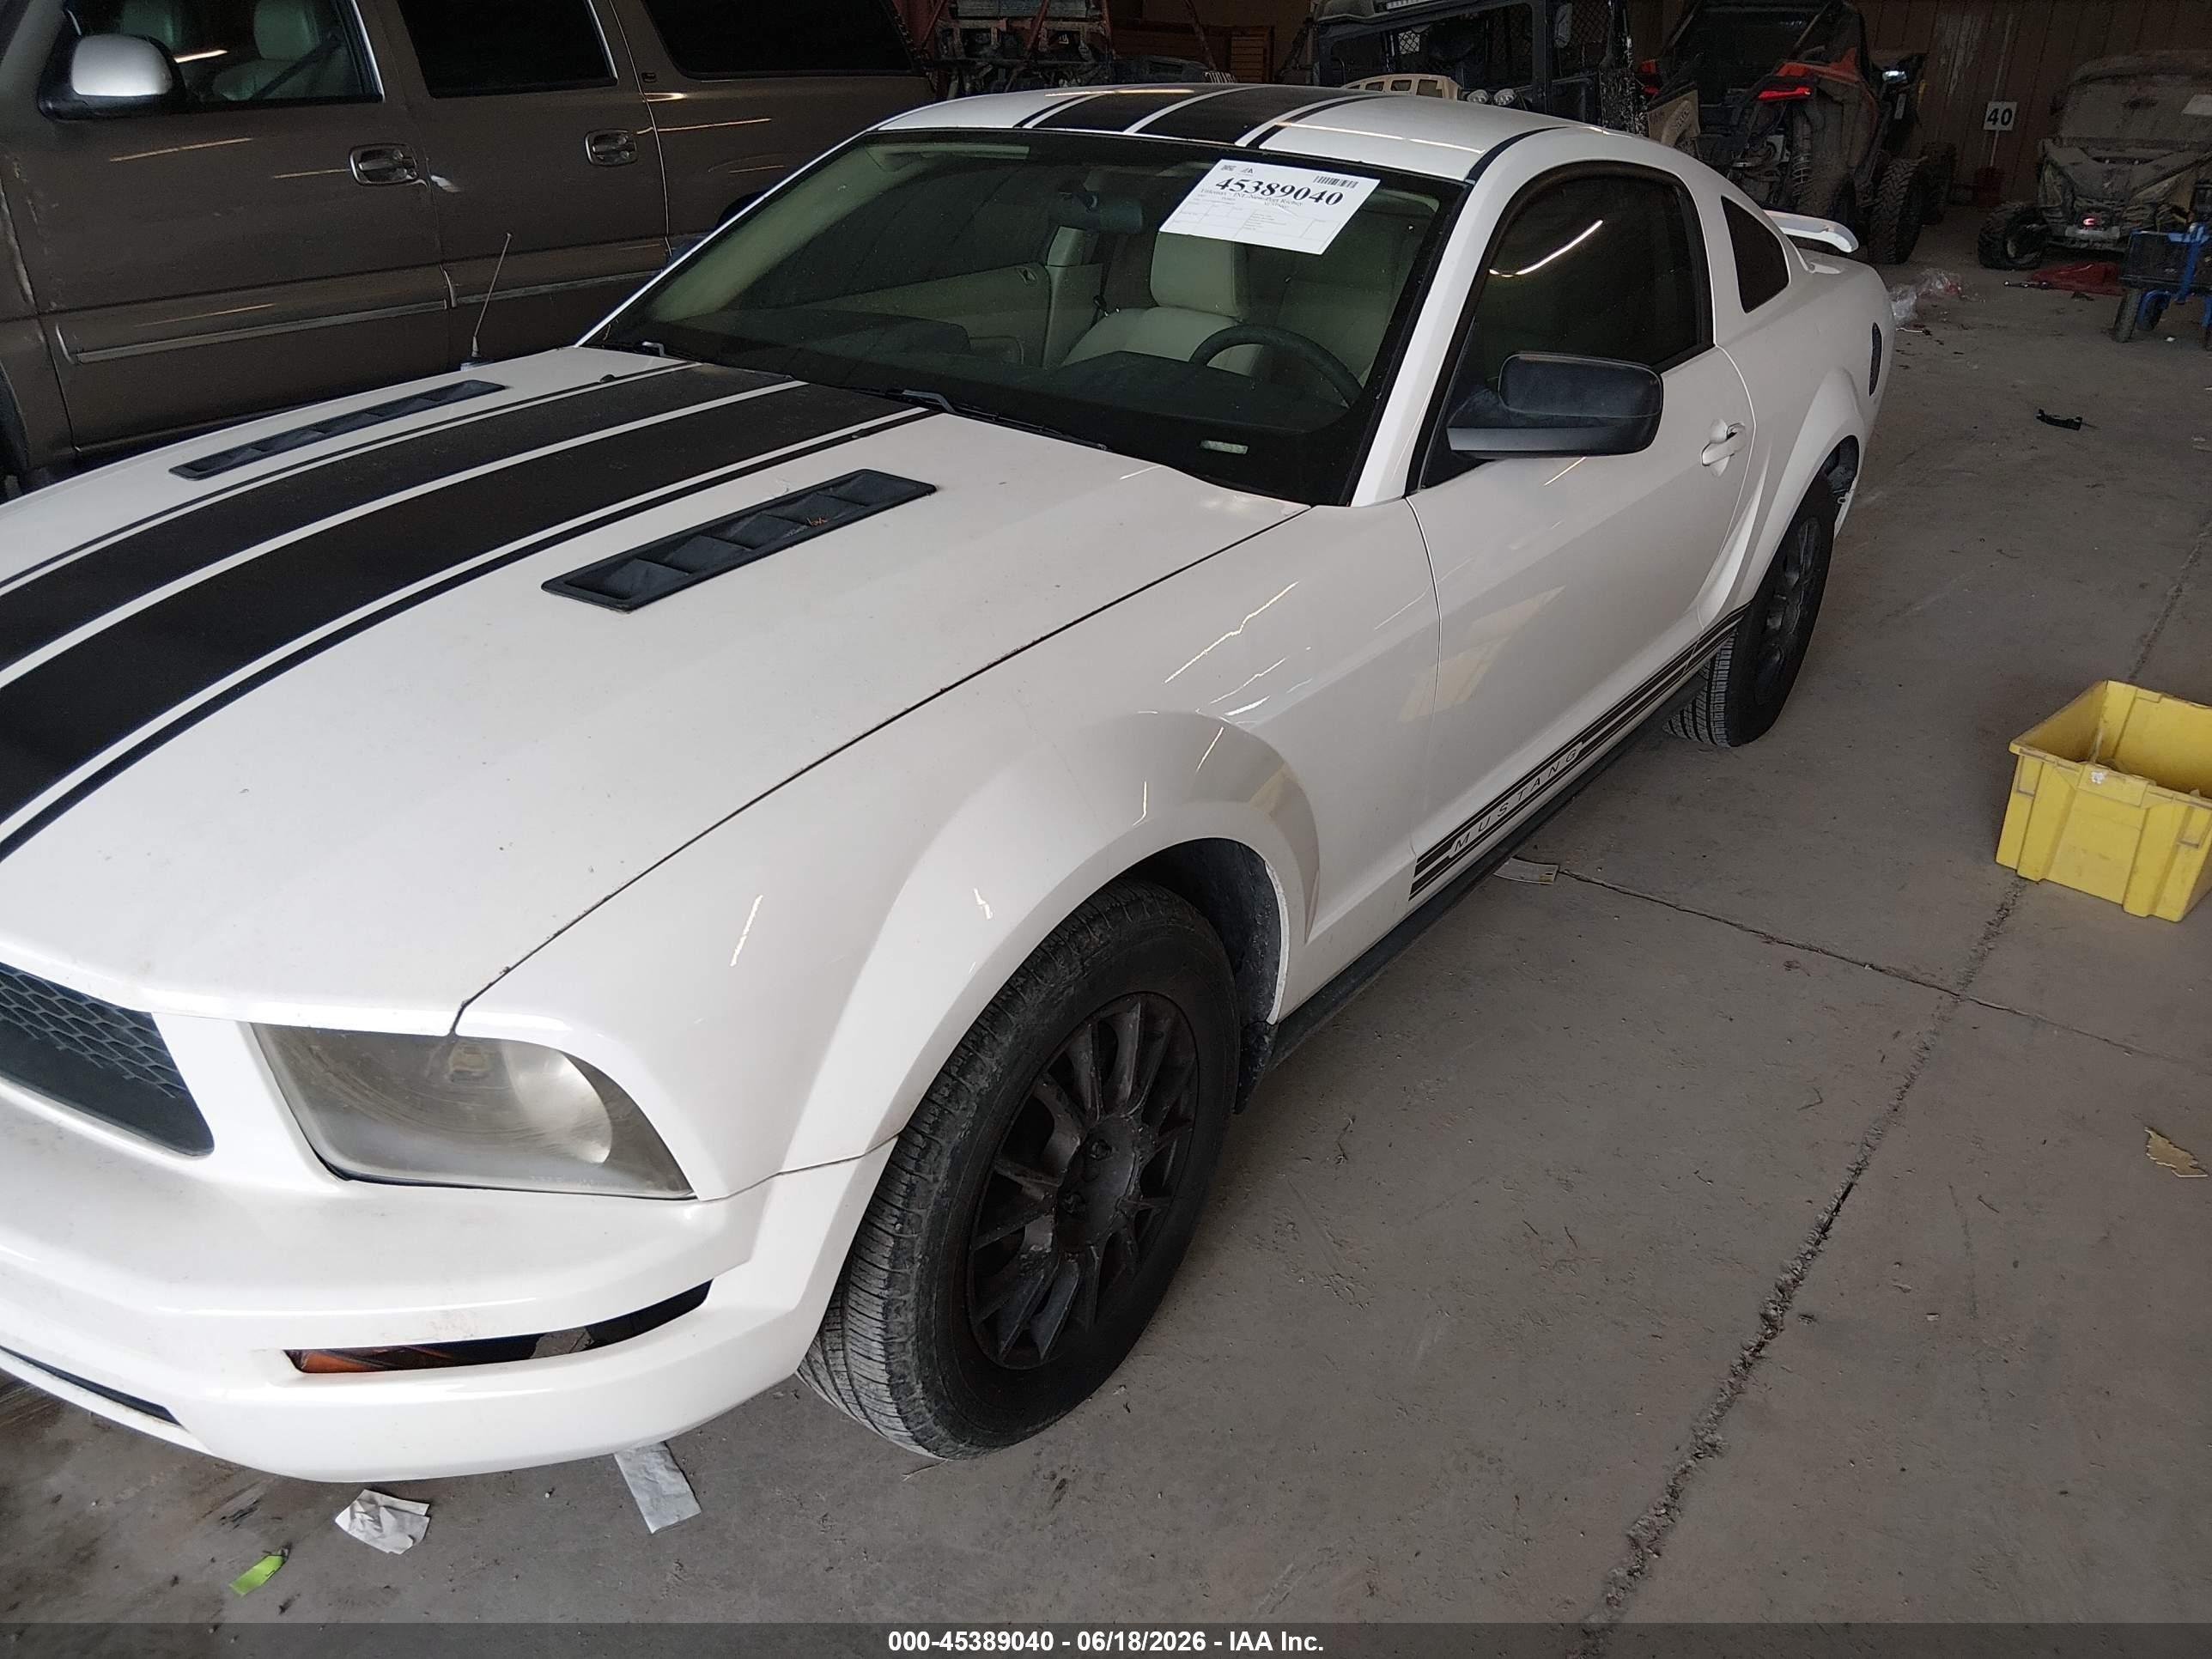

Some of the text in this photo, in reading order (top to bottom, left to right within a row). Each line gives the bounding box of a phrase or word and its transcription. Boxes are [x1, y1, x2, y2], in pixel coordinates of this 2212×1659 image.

[1987, 108, 2013, 126] 40
[1215, 177, 1344, 206] 45389040
[1454, 749, 1577, 852] MUSTANG
